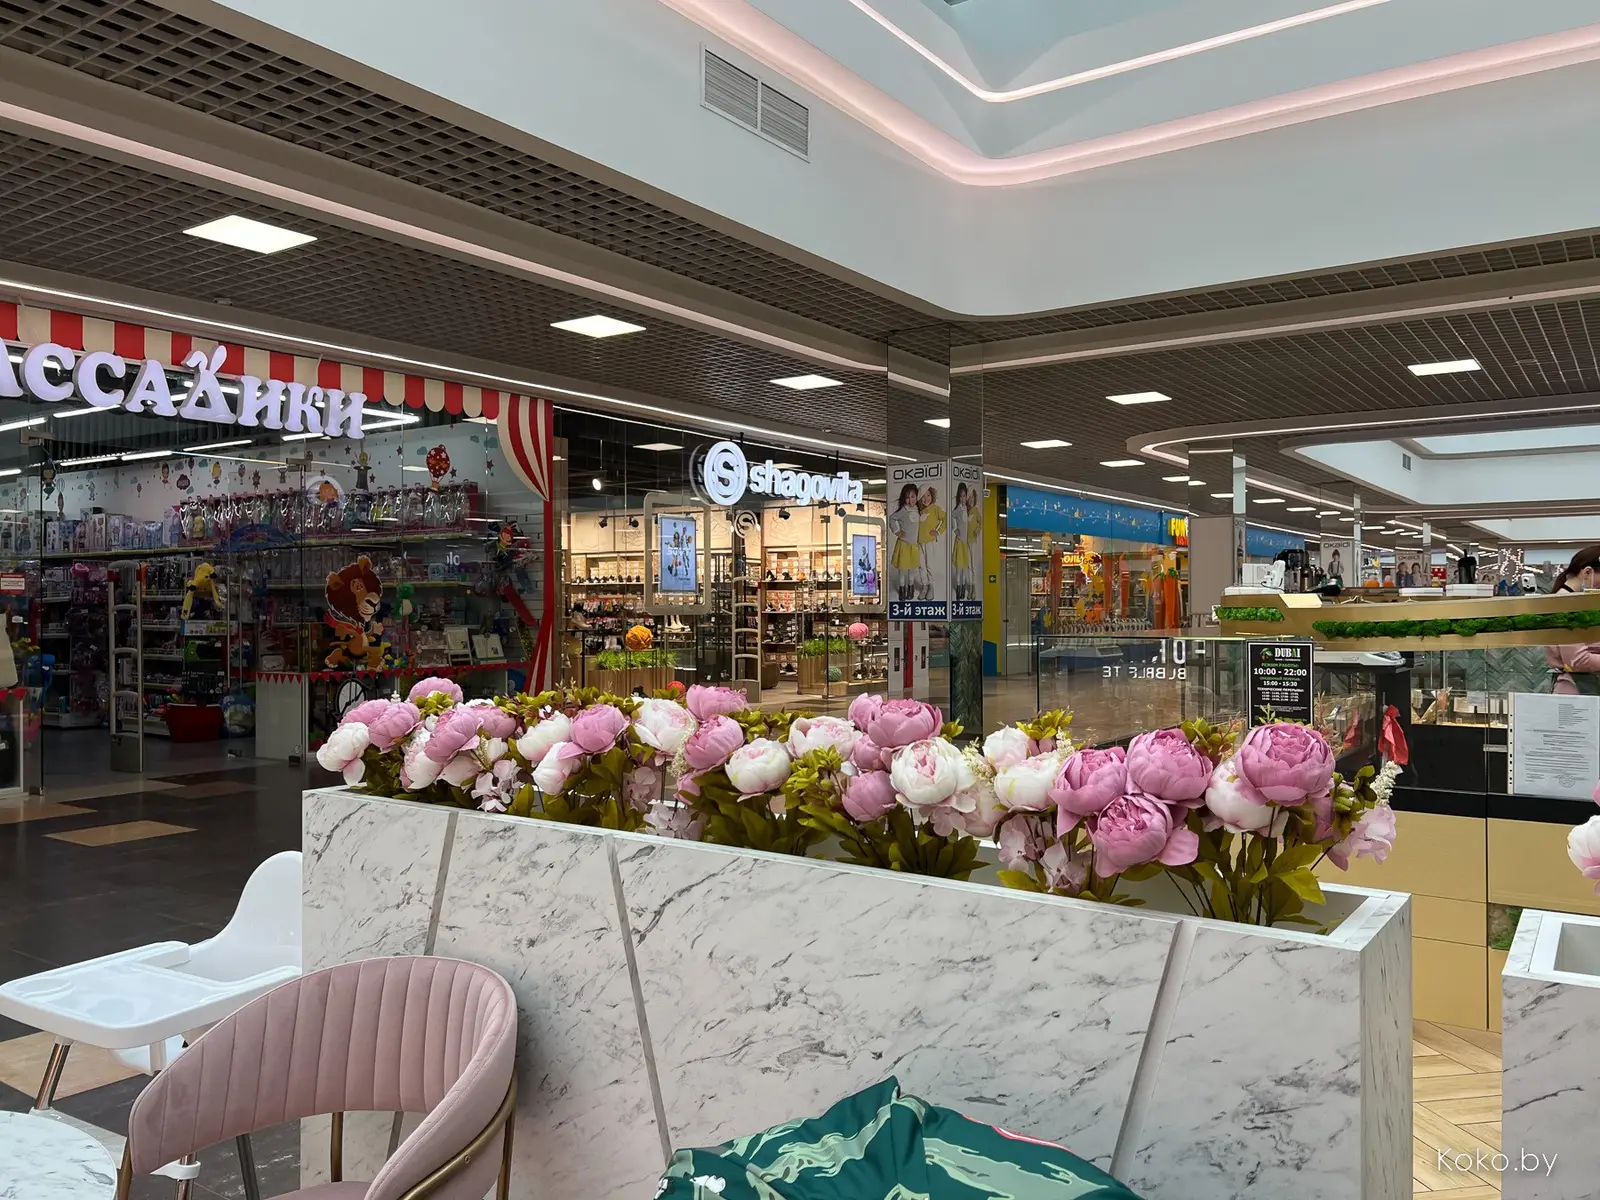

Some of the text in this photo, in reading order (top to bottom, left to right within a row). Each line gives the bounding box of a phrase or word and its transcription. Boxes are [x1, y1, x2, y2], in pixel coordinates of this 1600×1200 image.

[750, 459, 863, 505] shagovita
[892, 603, 946, 616] 3-й этаж
[952, 603, 982, 616] 3-й этаж
[1274, 647, 1301, 658] DUBAI
